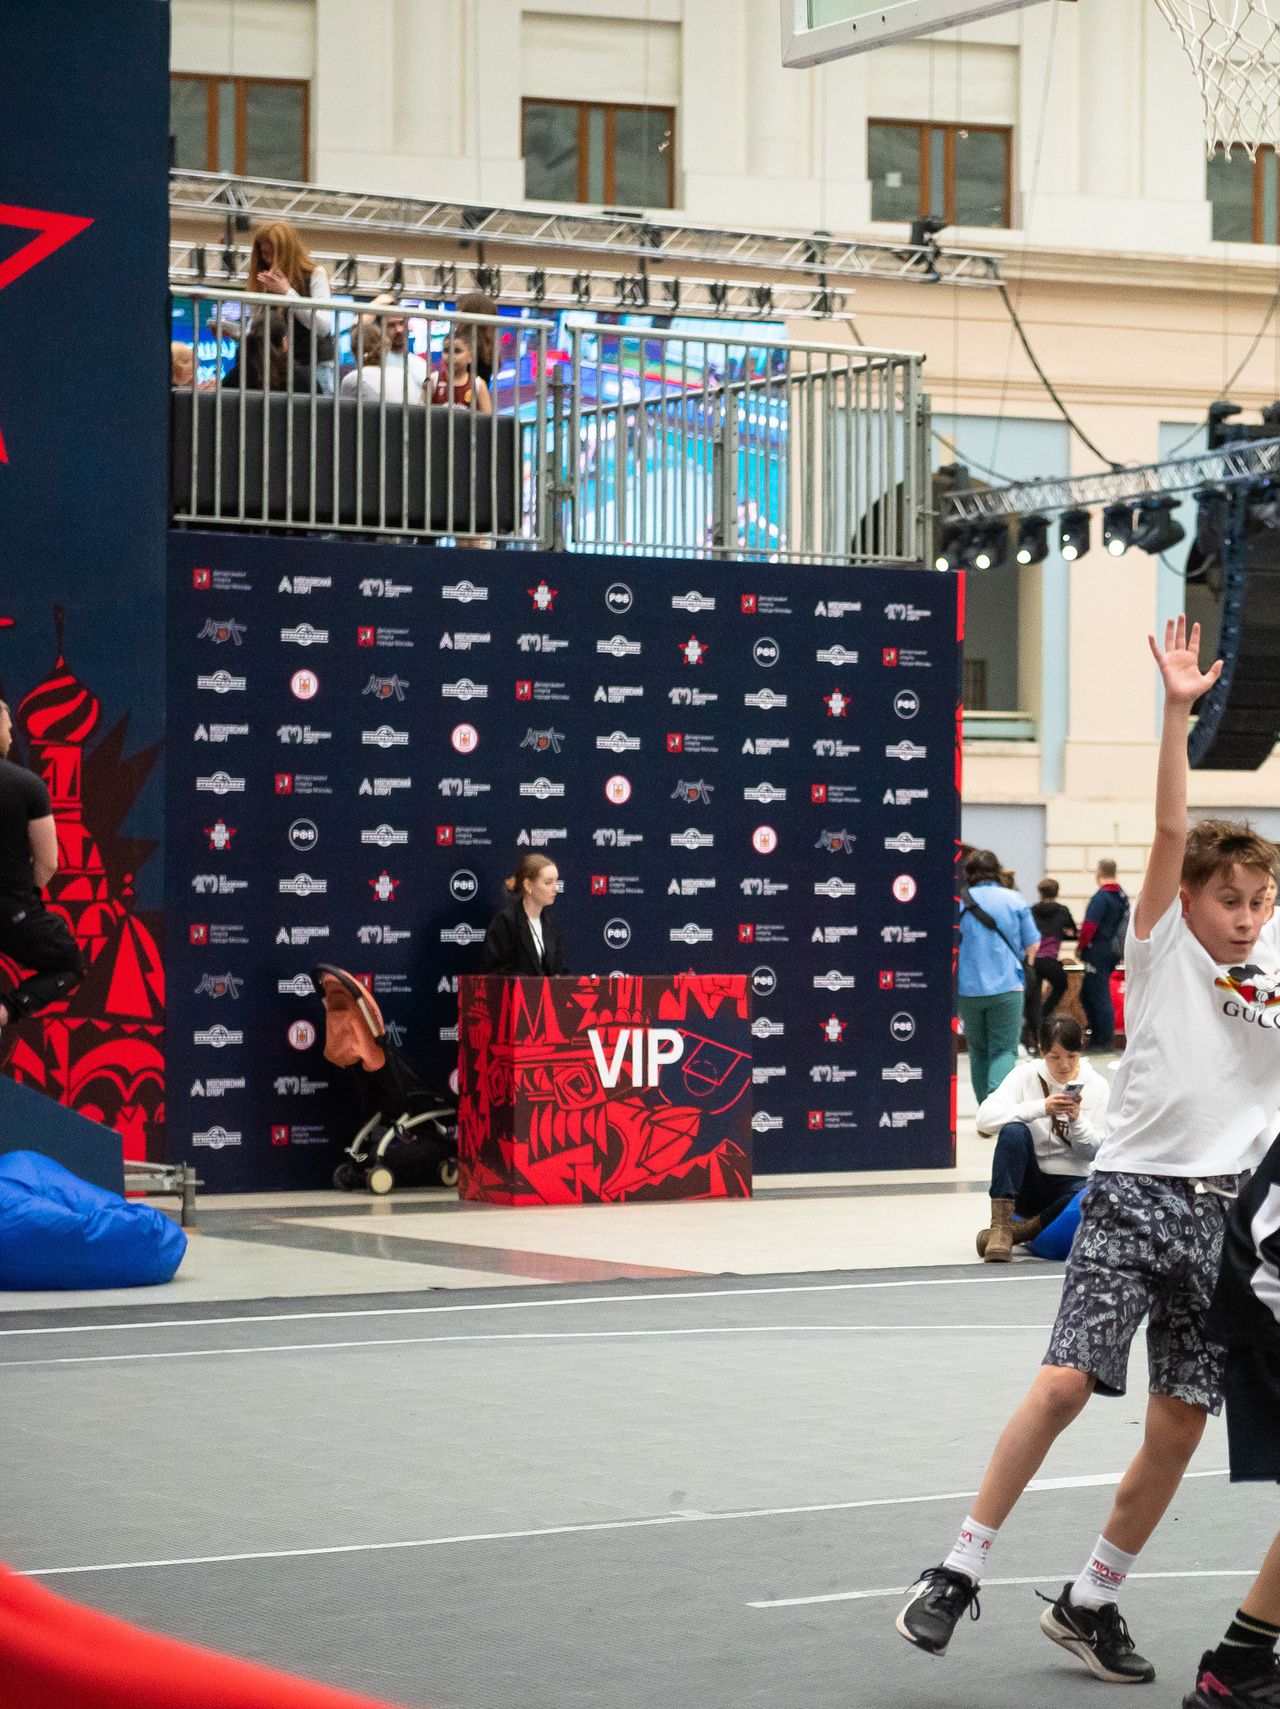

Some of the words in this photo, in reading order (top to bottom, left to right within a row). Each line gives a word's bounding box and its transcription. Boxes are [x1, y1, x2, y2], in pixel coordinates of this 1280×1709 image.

[608, 593, 629, 604] РФБ
[292, 830, 314, 841] РФБ
[453, 880, 474, 891] РФБ
[607, 928, 627, 939] РФБ
[587, 1028, 685, 1090] VIP
